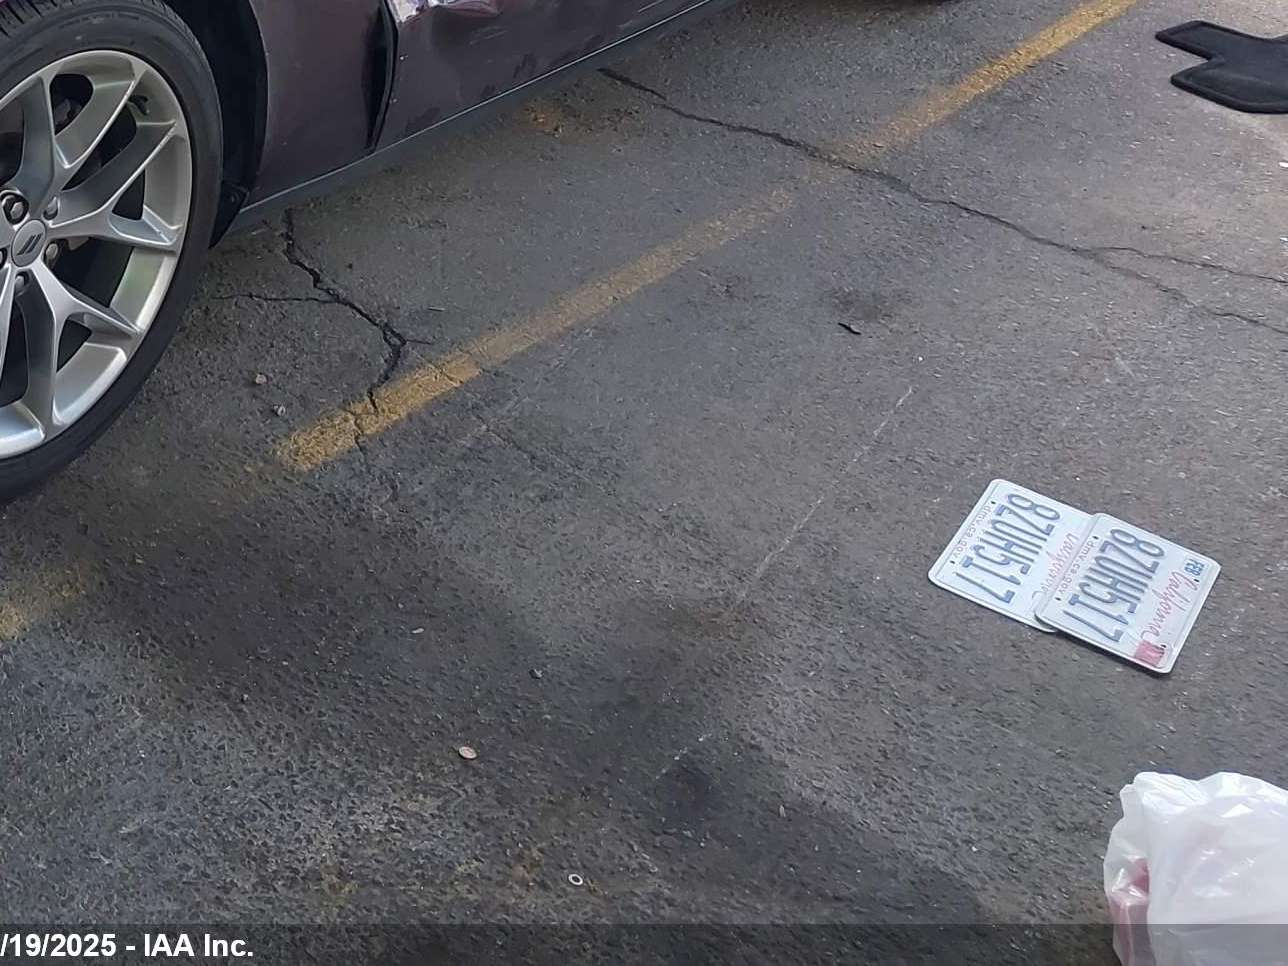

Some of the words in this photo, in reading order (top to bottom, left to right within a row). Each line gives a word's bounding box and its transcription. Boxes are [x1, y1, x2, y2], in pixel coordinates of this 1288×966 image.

[954, 505, 991, 559] dmv.ca.gov
[955, 493, 1061, 604] 8ZUH517
[1059, 540, 1096, 596] dmv.ca.gov
[1062, 528, 1165, 642] 8ZUH517
[1183, 558, 1206, 577] FEB
[1140, 571, 1199, 640] California
